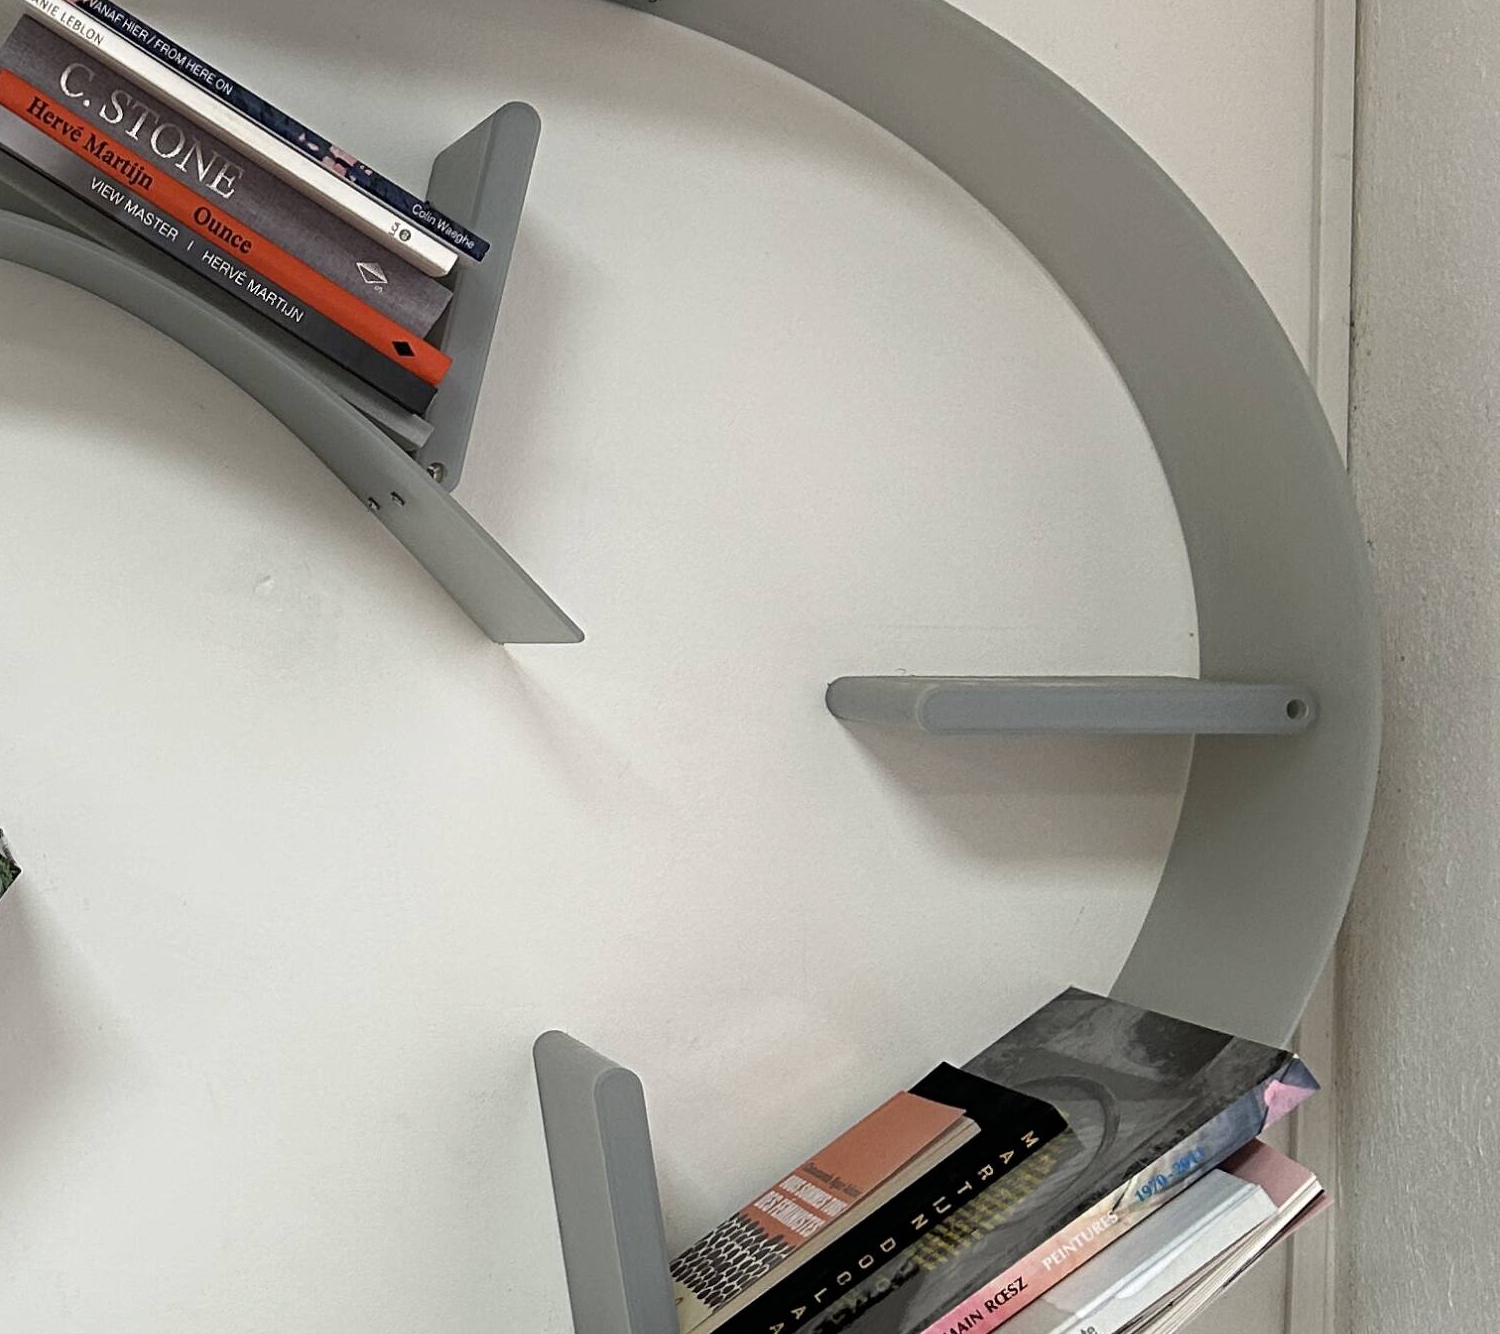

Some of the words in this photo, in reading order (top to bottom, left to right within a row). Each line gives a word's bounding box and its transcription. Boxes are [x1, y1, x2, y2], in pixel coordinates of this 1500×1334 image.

[58, 9, 107, 47] LEBLON
[119, 17, 150, 43] HIER
[151, 36, 190, 67] FROM
[183, 57, 218, 85] HERE
[213, 76, 236, 97] ON
[24, 94, 87, 145] Hervé
[78, 131, 159, 195] Martijn
[189, 202, 258, 257] Ounce
[53, 57, 106, 109] C.
[93, 84, 251, 202] STONE
[86, 176, 126, 208] VIEW
[120, 198, 182, 244] MASTER
[200, 246, 251, 287] HERVÉ
[244, 277, 307, 325] MARTIJN
[408, 201, 439, 226] Colin
[432, 217, 479, 252] Waeghe
[980, 1273, 1030, 1315] RŒSZ
[1038, 1207, 1120, 1272] PEINTURES
